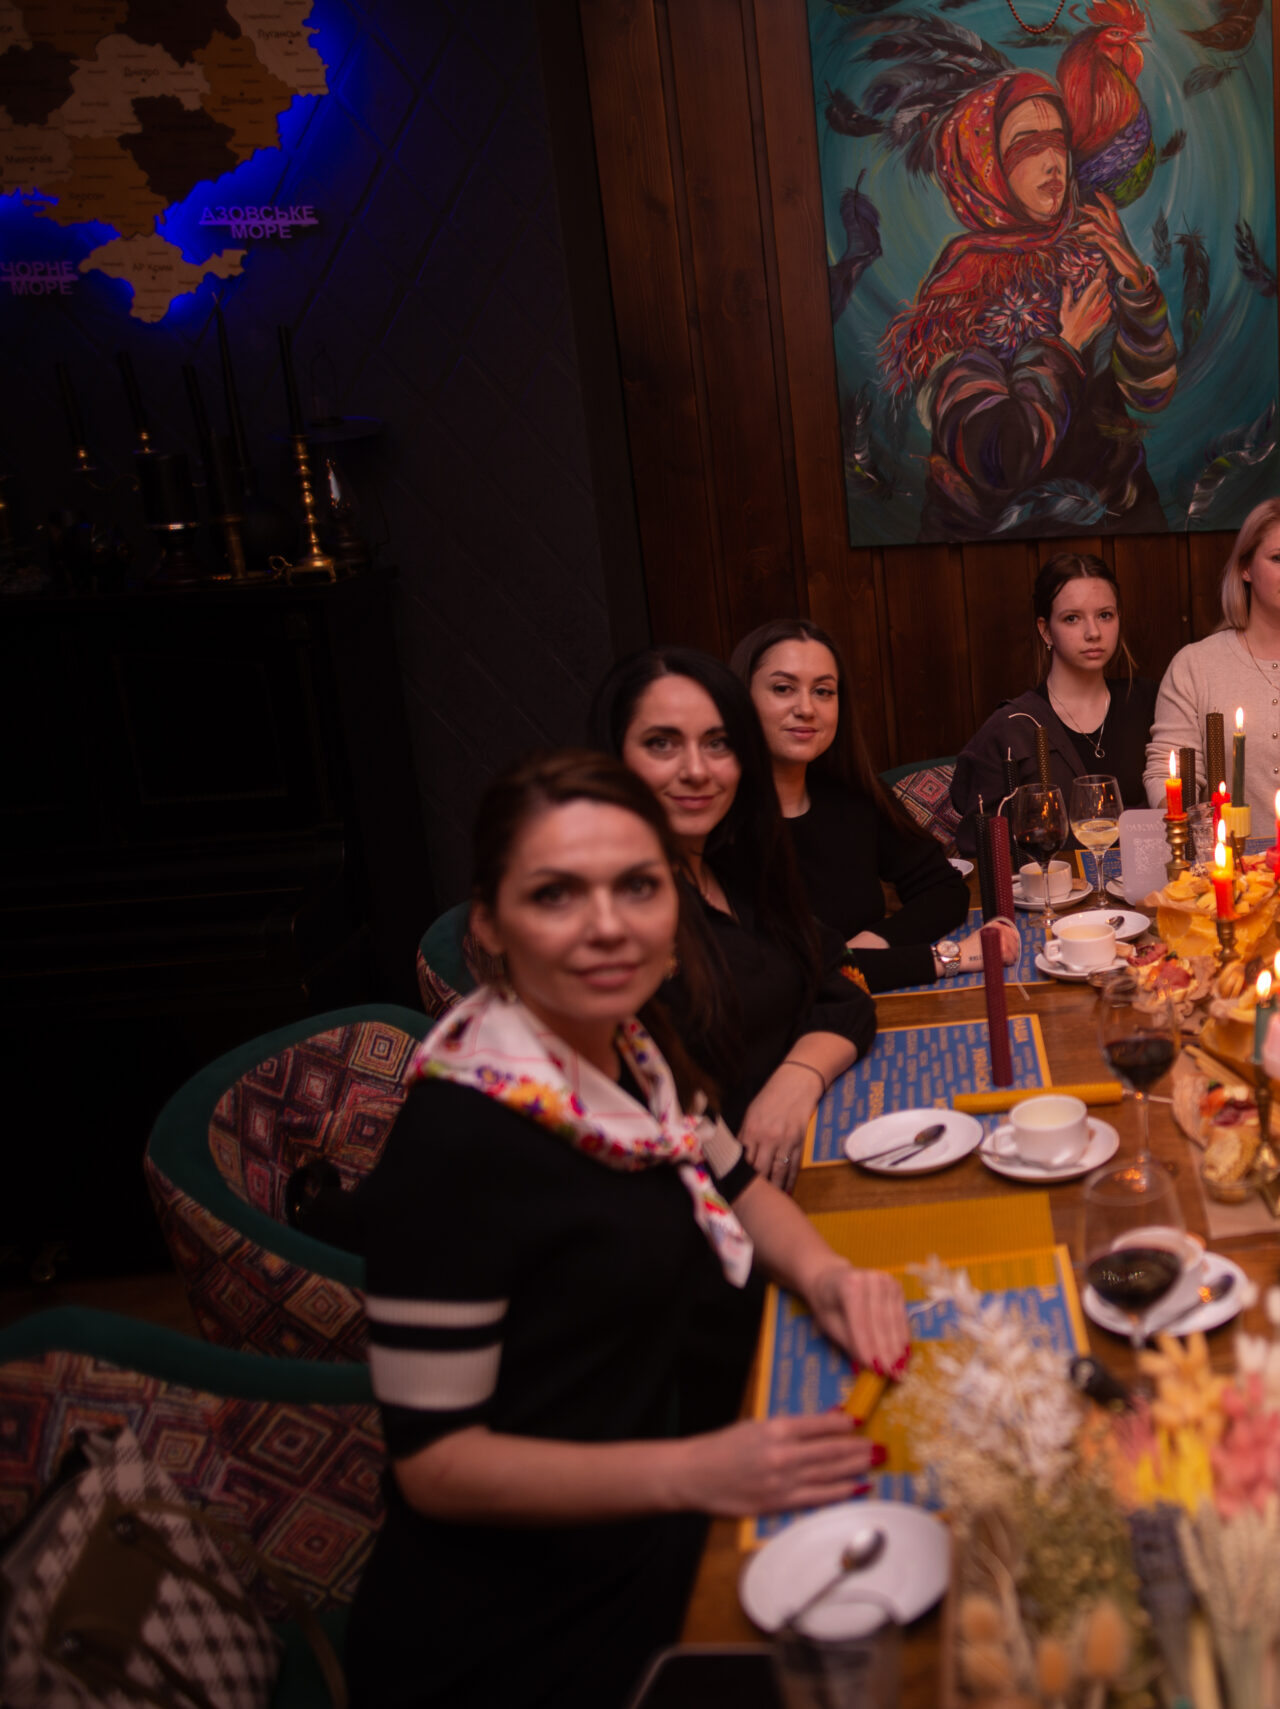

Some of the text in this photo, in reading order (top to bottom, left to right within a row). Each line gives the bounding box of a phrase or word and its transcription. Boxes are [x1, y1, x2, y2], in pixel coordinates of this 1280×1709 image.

[200, 205, 315, 222] АЗОВСЬКЕ
[231, 223, 292, 240] МОРЕ
[0, 260, 75, 277] ЧОРНЕ
[11, 280, 75, 296] МОРЕ
